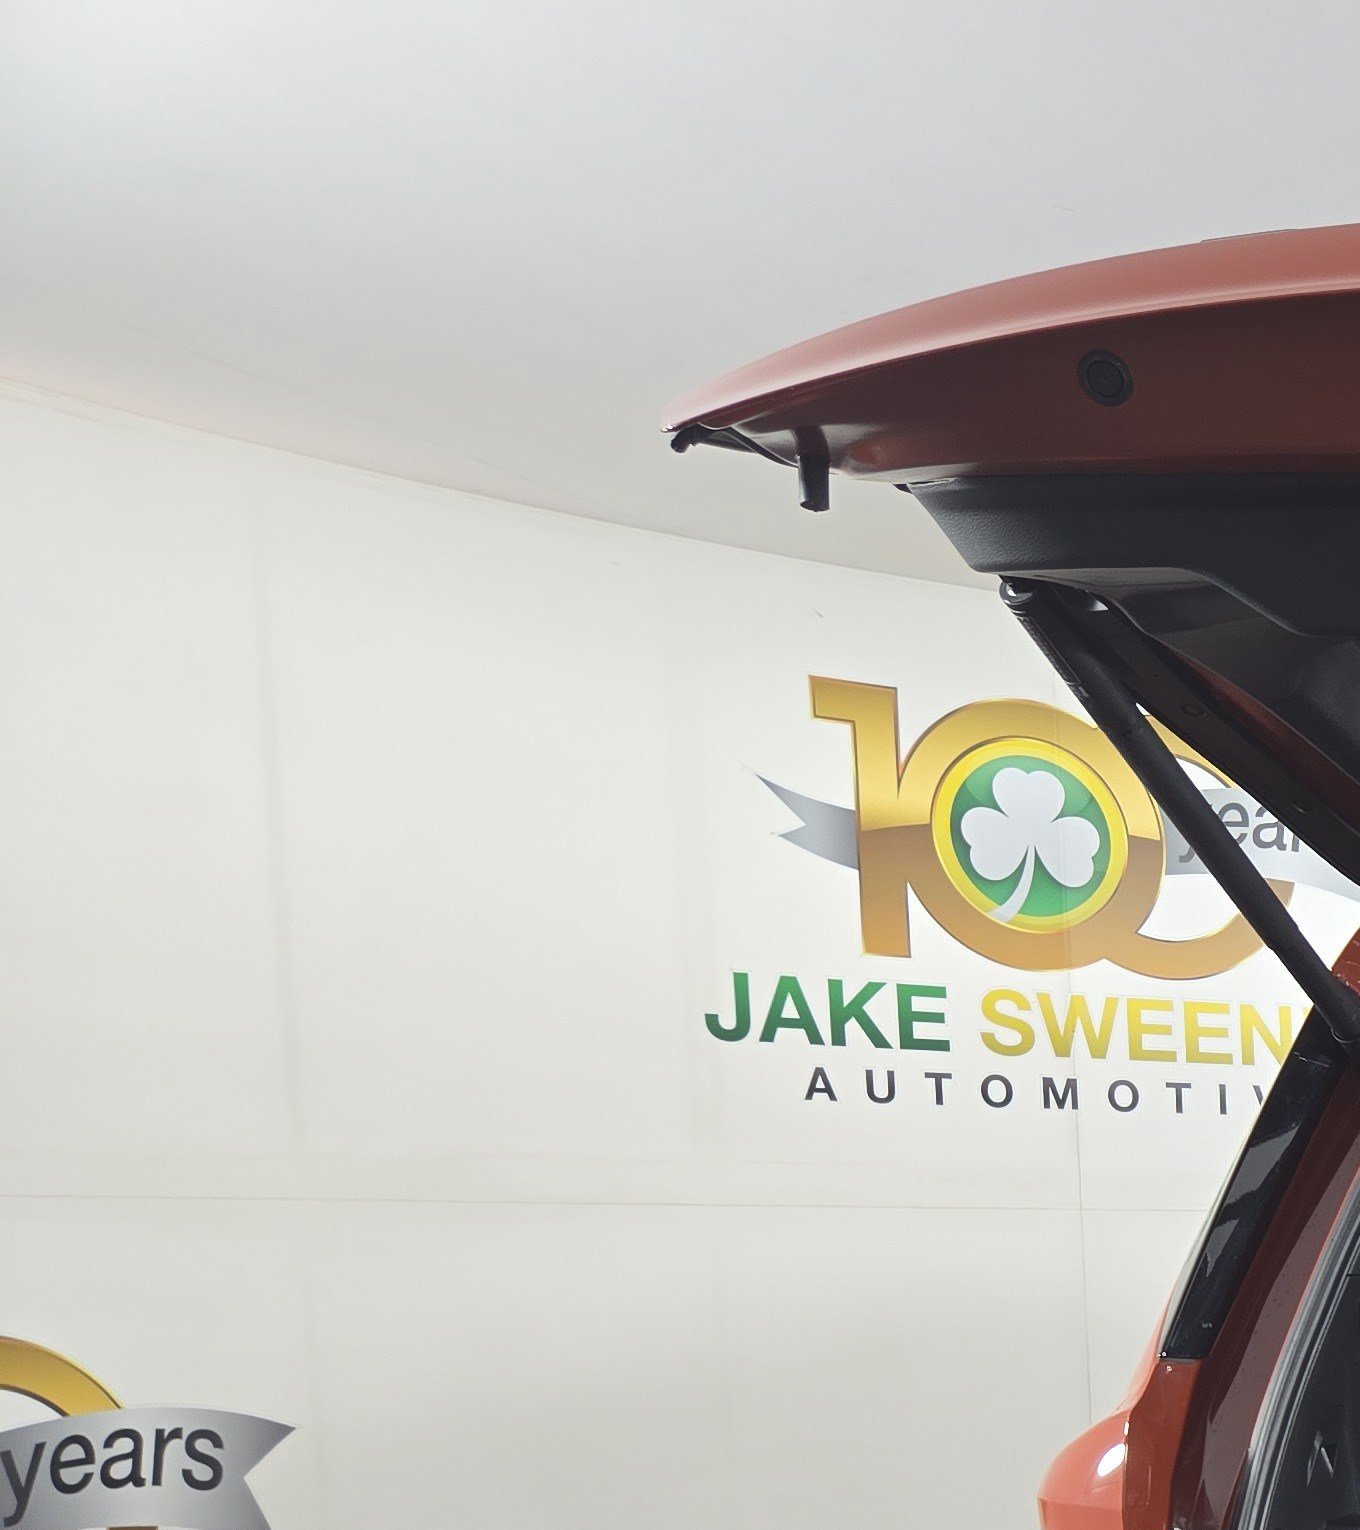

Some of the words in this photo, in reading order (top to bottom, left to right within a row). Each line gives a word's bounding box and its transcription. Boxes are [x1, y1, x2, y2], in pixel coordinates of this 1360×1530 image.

[704, 971, 951, 1051] JAKE
[980, 988, 1311, 1065] SWEEN
[0, 1426, 225, 1527] years
